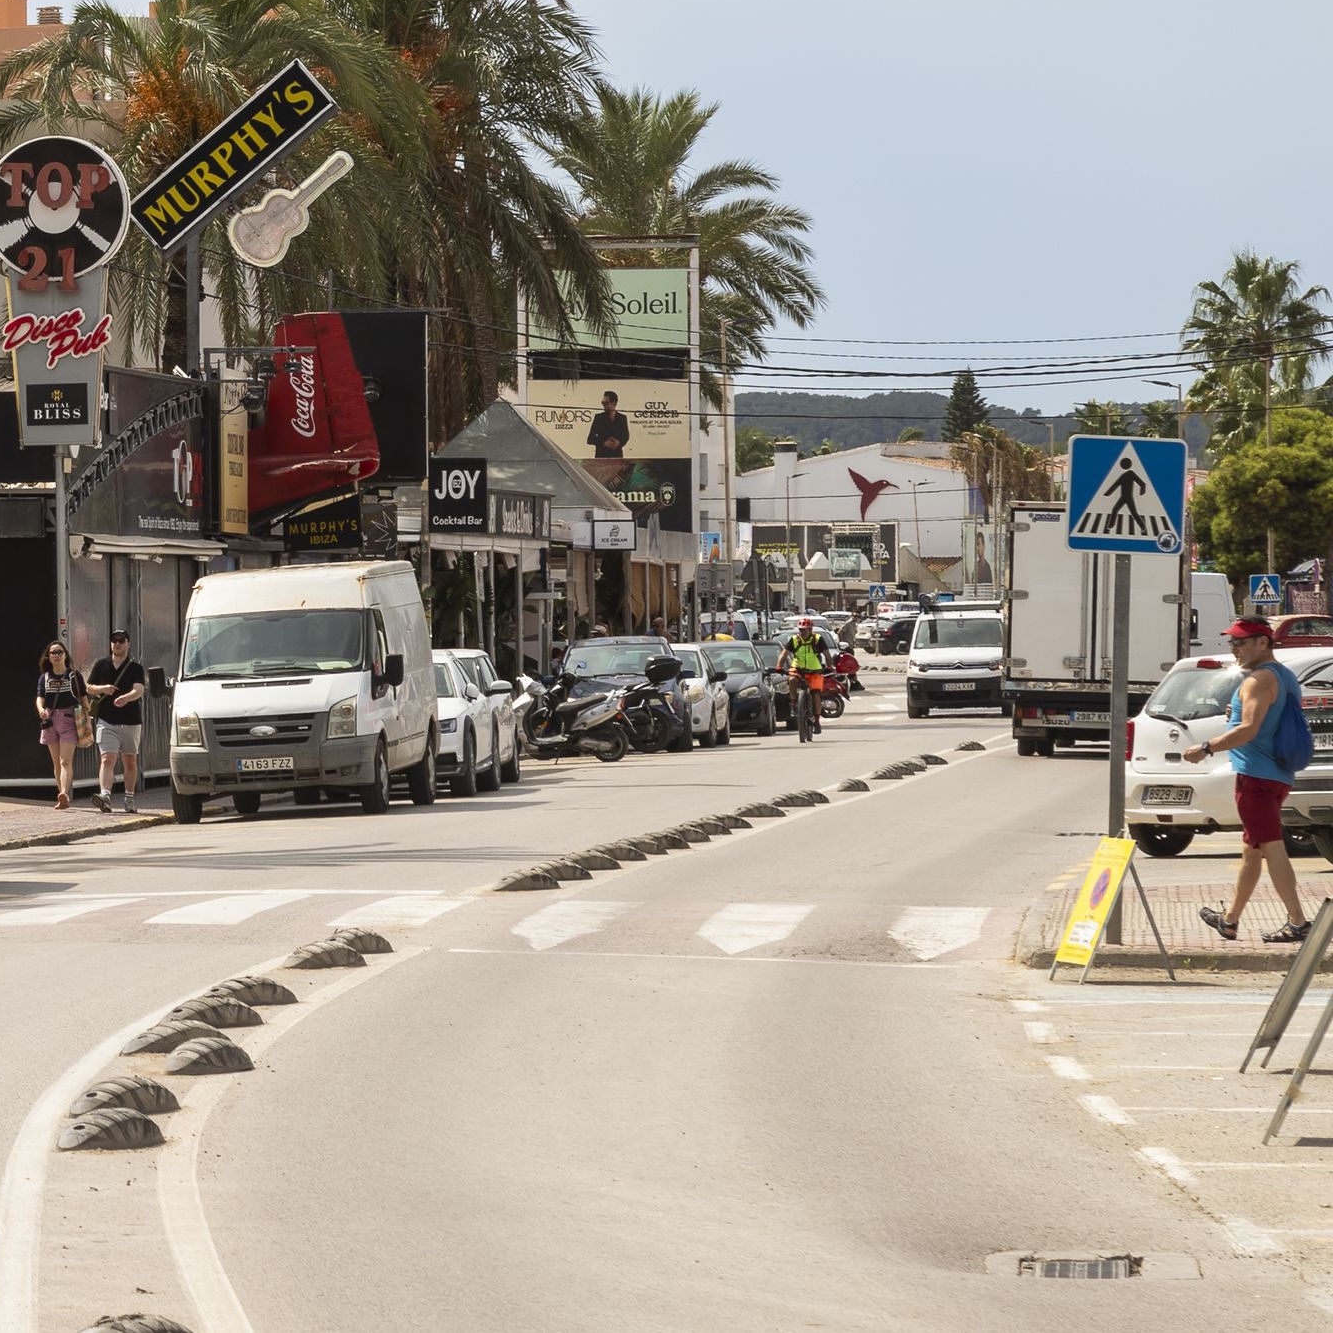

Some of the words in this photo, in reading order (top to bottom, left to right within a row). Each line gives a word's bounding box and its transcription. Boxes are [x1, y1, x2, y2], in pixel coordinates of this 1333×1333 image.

[143, 80, 315, 236] MURPHY'S
[0, 162, 111, 210] TOP
[18, 246, 80, 293] 21
[2, 307, 85, 352] Disco
[47, 314, 113, 369] Pub
[34, 408, 81, 420] BLISS
[644, 401, 669, 410] GUY
[434, 469, 481, 500] JOY
[289, 519, 359, 535] MURPHY'S
[432, 515, 466, 526] Cocktail
[467, 515, 483, 526] Bar
[310, 535, 339, 545] IBIZA
[243, 760, 269, 770] 4163
[271, 759, 292, 769] FZZ
